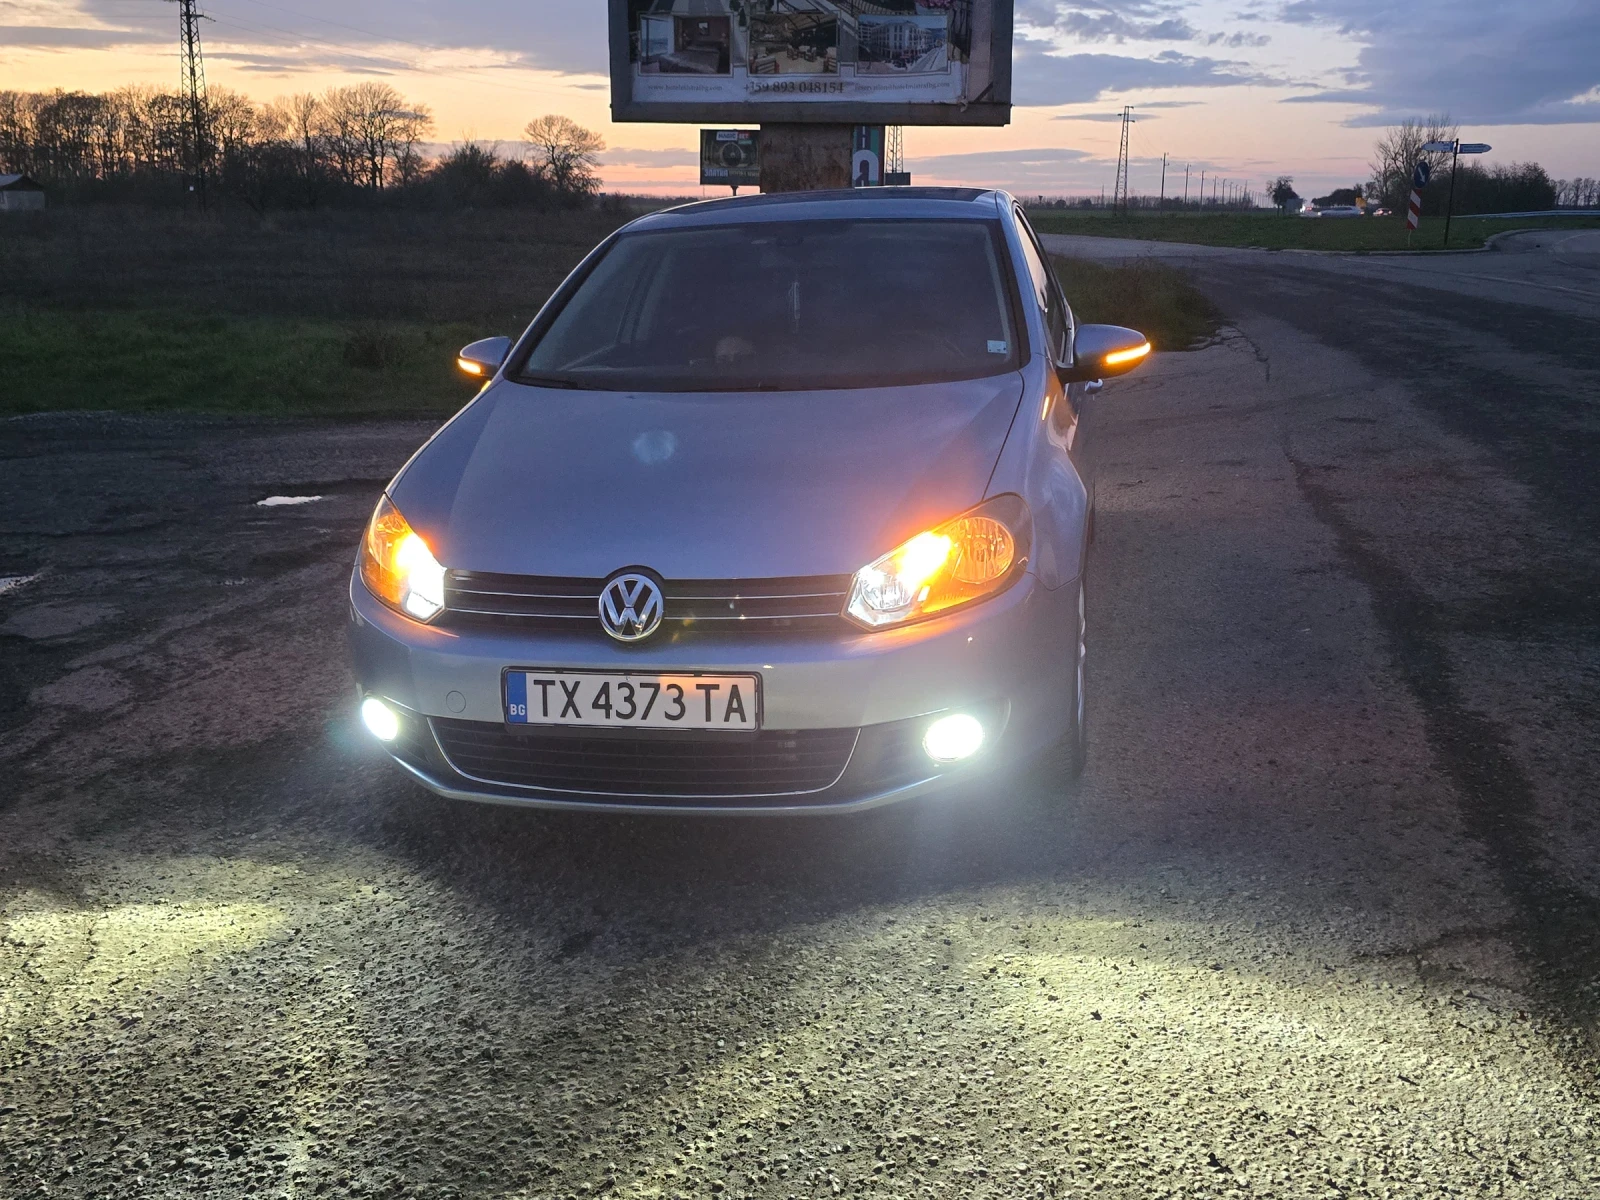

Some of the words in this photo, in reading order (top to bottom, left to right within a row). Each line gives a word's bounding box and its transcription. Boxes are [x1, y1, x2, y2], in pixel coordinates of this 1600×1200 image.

[772, 82, 795, 93] 893
[799, 82, 844, 93] 048154
[533, 679, 582, 719] TX
[591, 681, 686, 721] 4373
[695, 683, 747, 723] TA
[510, 703, 526, 716] BG
